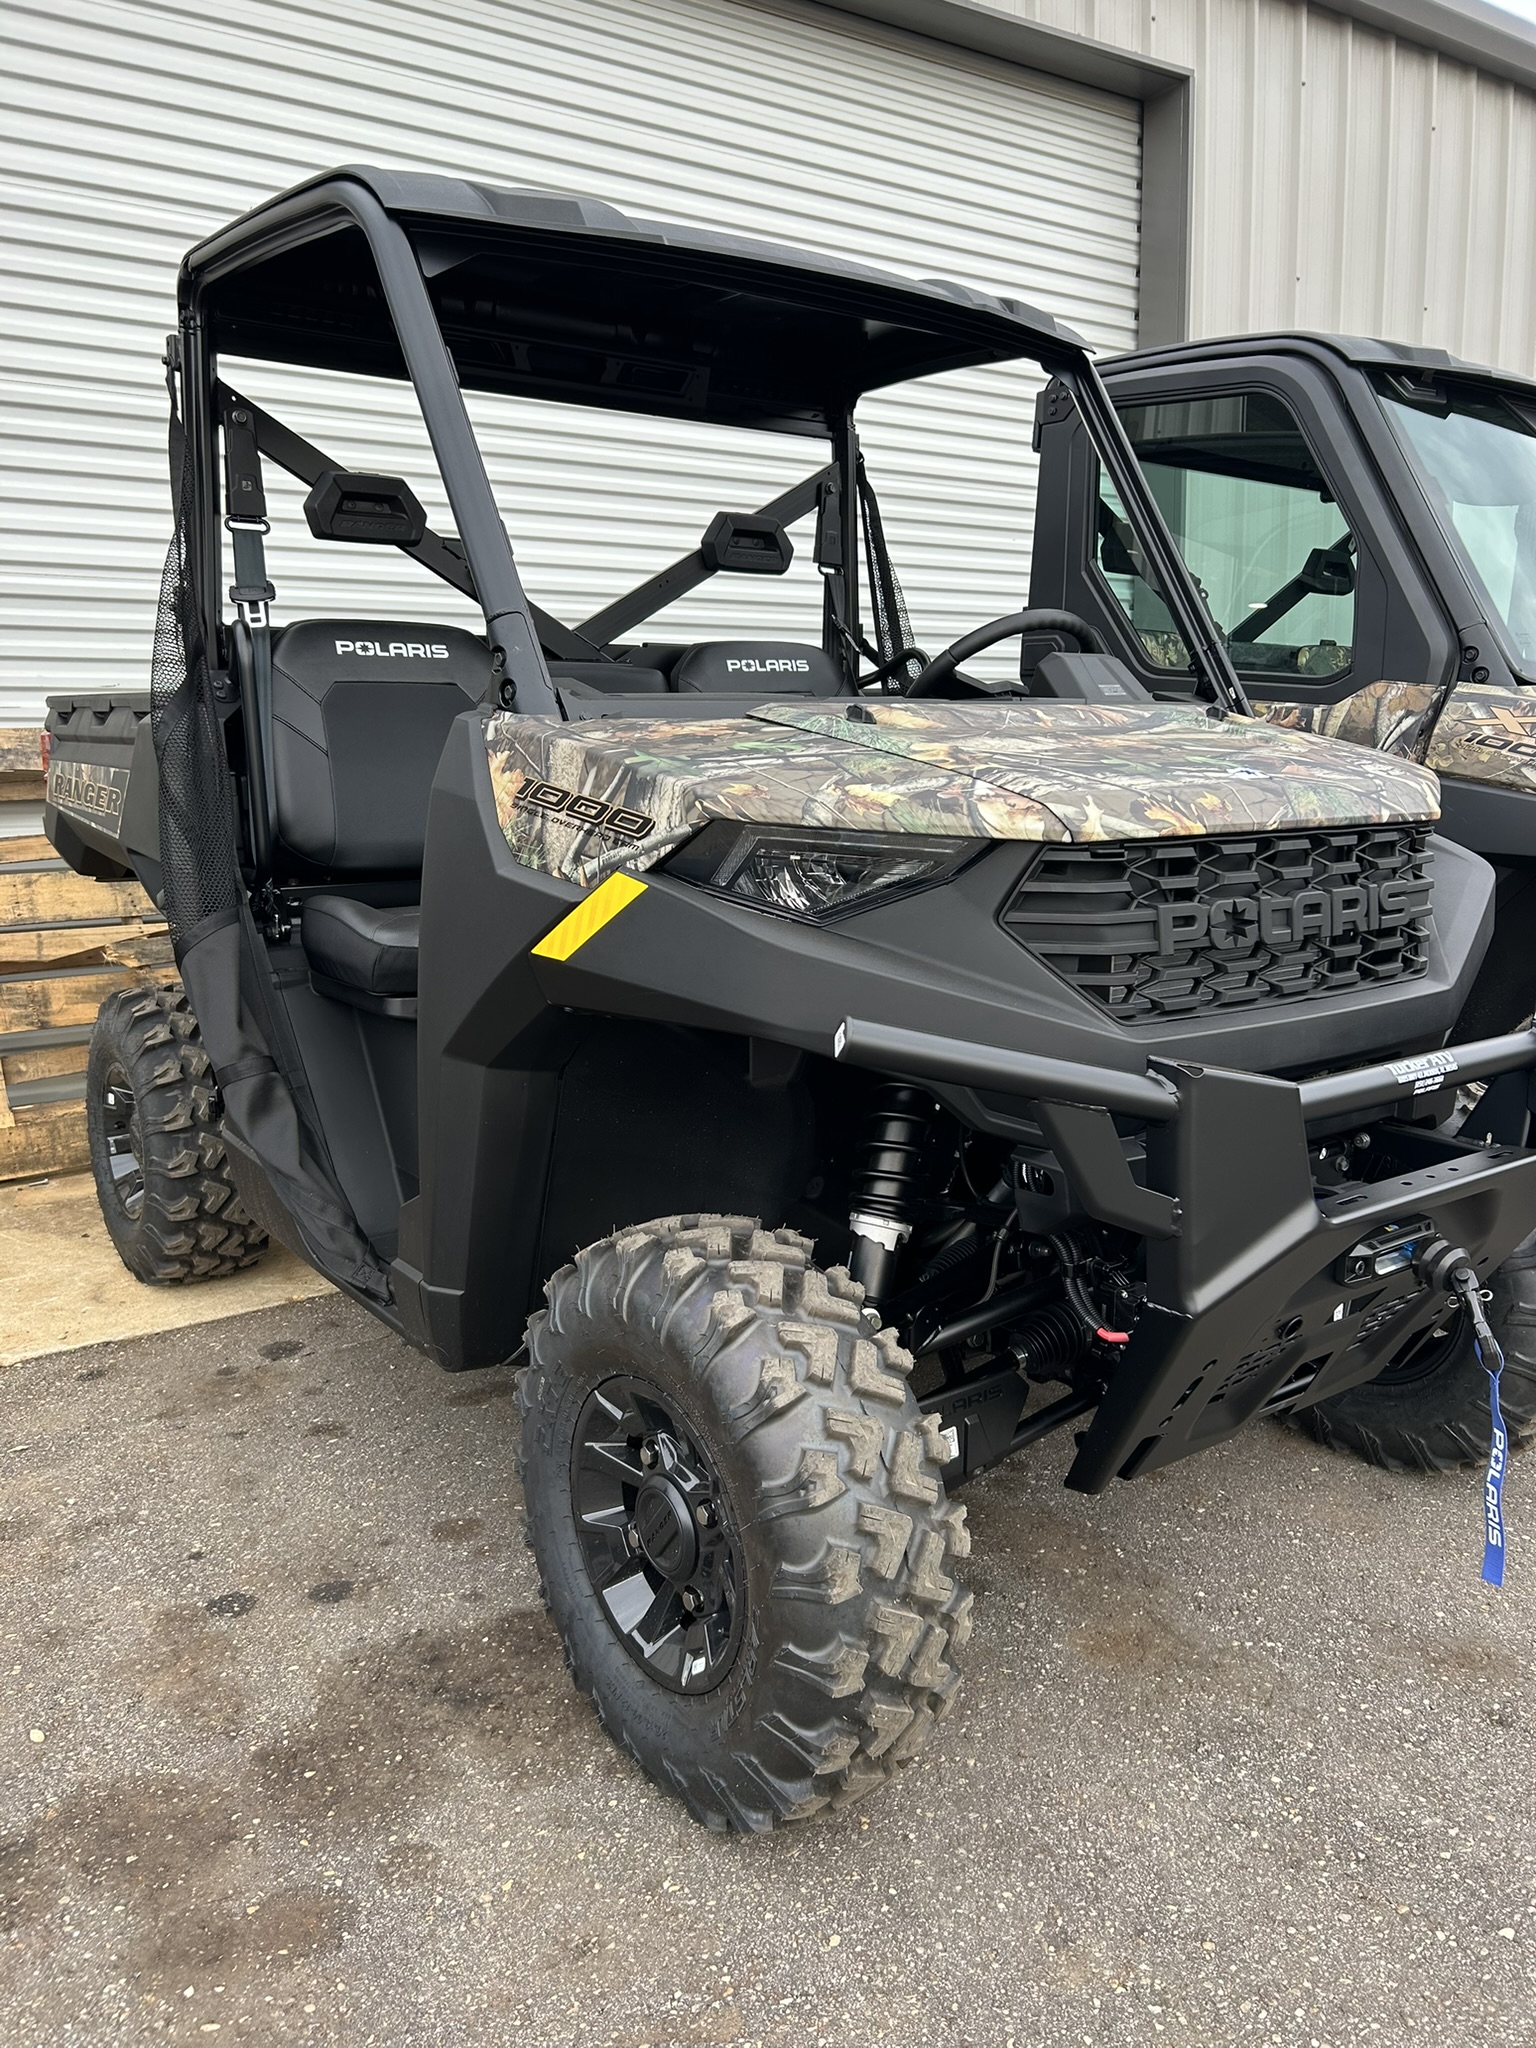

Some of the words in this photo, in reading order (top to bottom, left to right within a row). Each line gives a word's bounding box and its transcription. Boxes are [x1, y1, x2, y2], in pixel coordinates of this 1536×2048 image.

[335, 640, 450, 659] POLARIS
[726, 659, 810, 672] POLARIS
[1458, 704, 1536, 738] X
[1463, 731, 1536, 758] 100
[53, 773, 122, 816] RANGER
[514, 775, 656, 840] 1000
[510, 802, 549, 820] SINGLE
[550, 816, 612, 842] OVERHEAD
[1156, 879, 1411, 956] POLARIS
[1428, 1050, 1455, 1068] ATV
[941, 1383, 1003, 1416] LARIS
[1486, 1427, 1505, 1548] POLARIS
